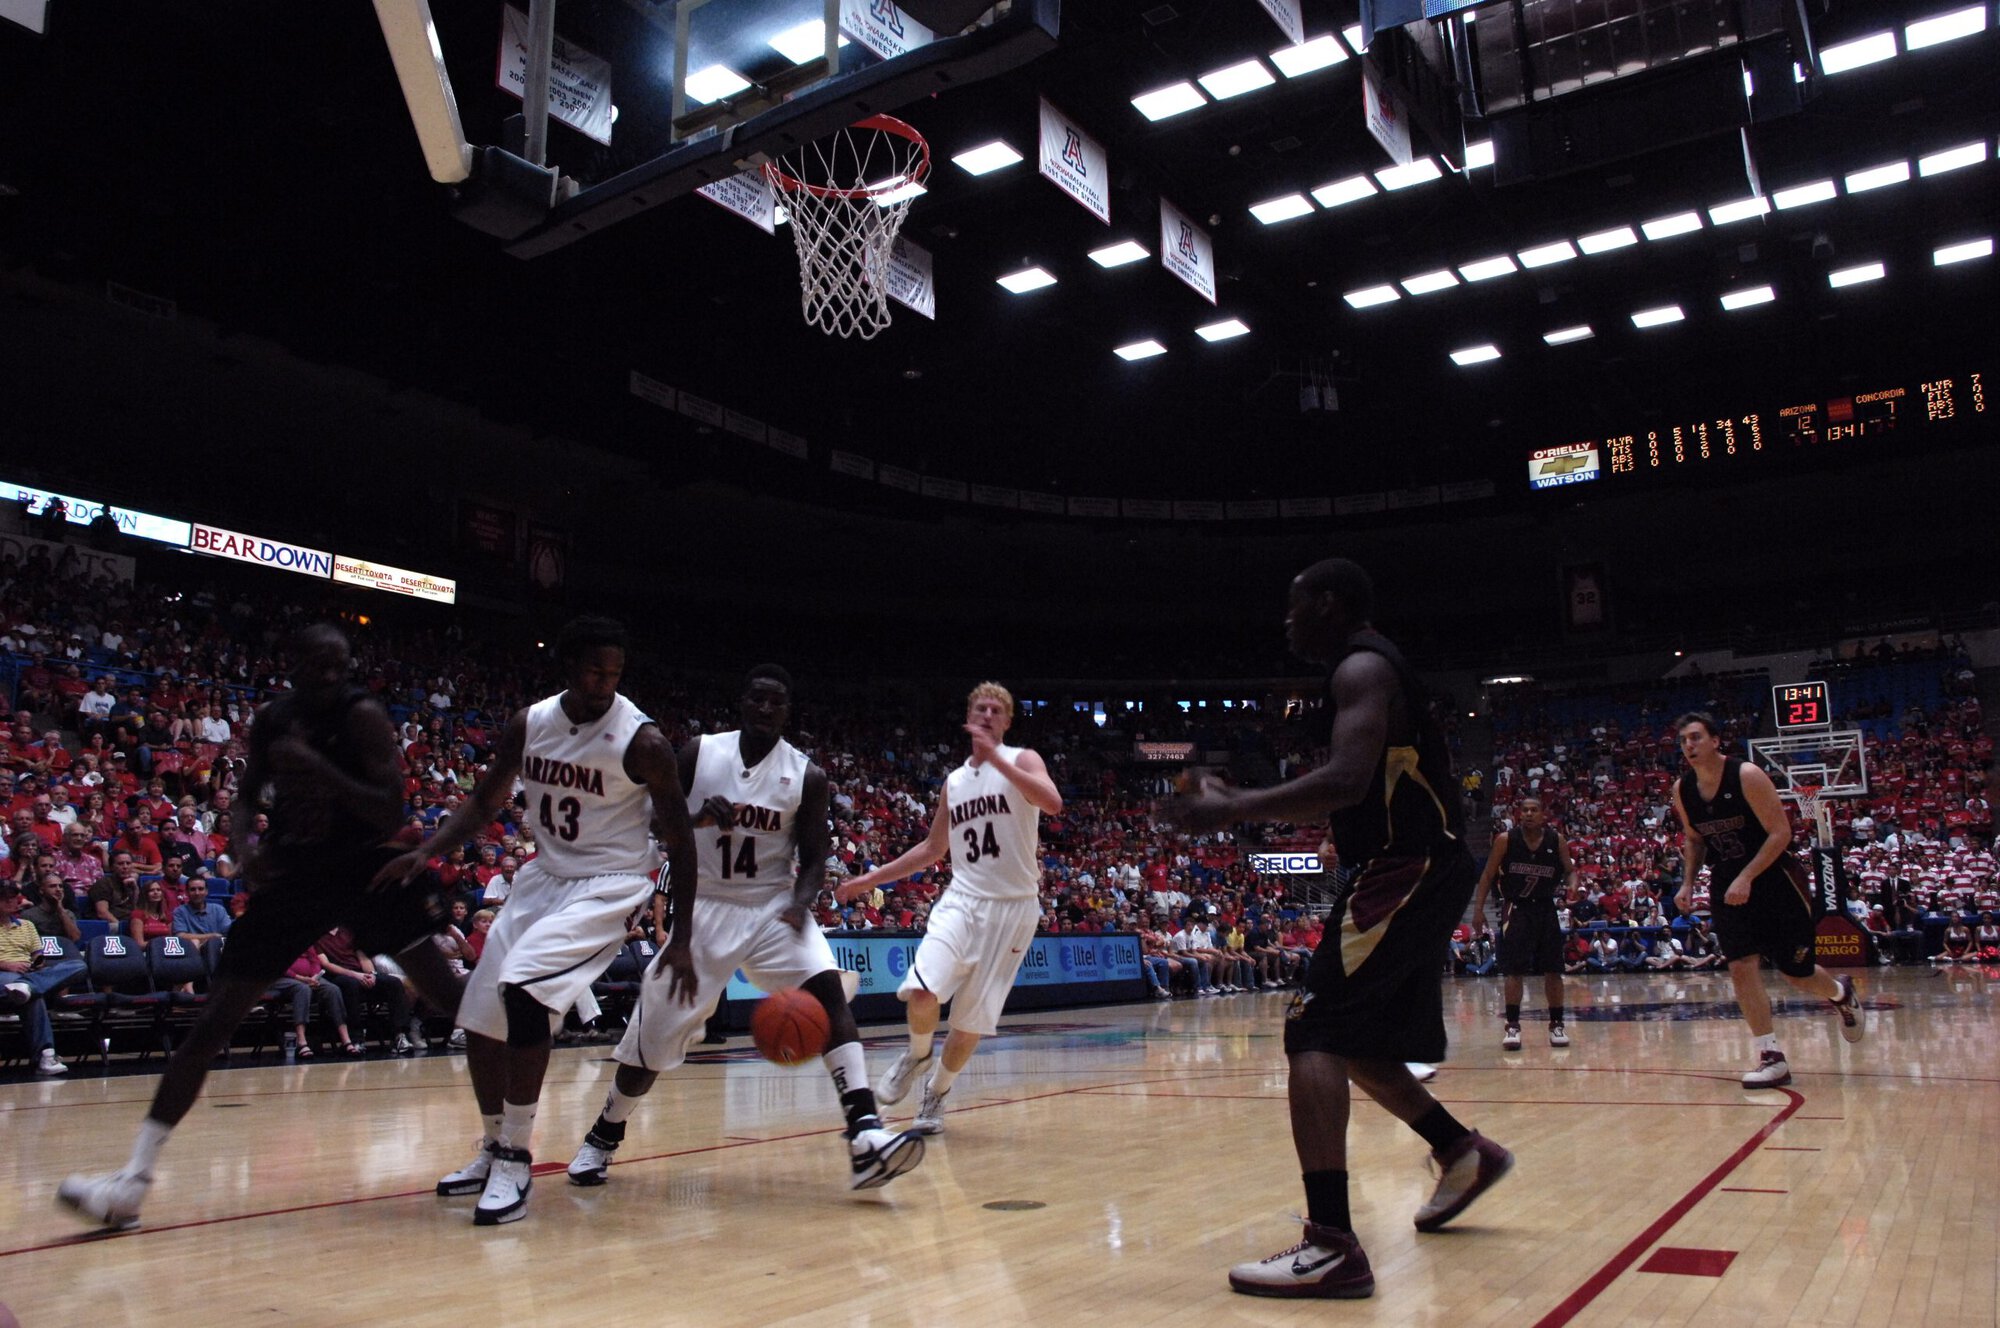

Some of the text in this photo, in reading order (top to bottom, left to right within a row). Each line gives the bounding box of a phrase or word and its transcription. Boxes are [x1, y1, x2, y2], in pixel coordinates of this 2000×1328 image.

[1920, 379, 1953, 393] PLYR
[1855, 387, 1907, 404] CONCORDIA
[1927, 390, 1950, 401] PTS
[1779, 404, 1817, 417] ARIZONA
[1927, 399, 1954, 411] RBS
[1798, 416, 1811, 429] 12
[1928, 409, 1955, 421] FLS
[1533, 442, 1591, 459] O'RIELLY
[1607, 436, 1633, 448] PLYR
[1612, 445, 1630, 455] PTS
[1612, 453, 1633, 464] RBS
[1536, 471, 1595, 488] WATSON
[335, 562, 392, 581] DESERT TOYOTA
[400, 576, 426, 588] DESERT
[428, 583, 454, 594] TOYOTA
[1784, 686, 1822, 701] 13:41
[1789, 702, 1818, 724] 23
[525, 756, 604, 797] ARIZONA
[540, 793, 580, 841] 43
[951, 795, 1011, 829] ARIZONA
[964, 822, 1000, 863] 34
[716, 835, 757, 879] 14
[1252, 856, 1322, 872] GEICO
[1519, 875, 1539, 898] 7
[1820, 852, 1838, 911] ARIZONA
[1815, 945, 1859, 955] FARGO
